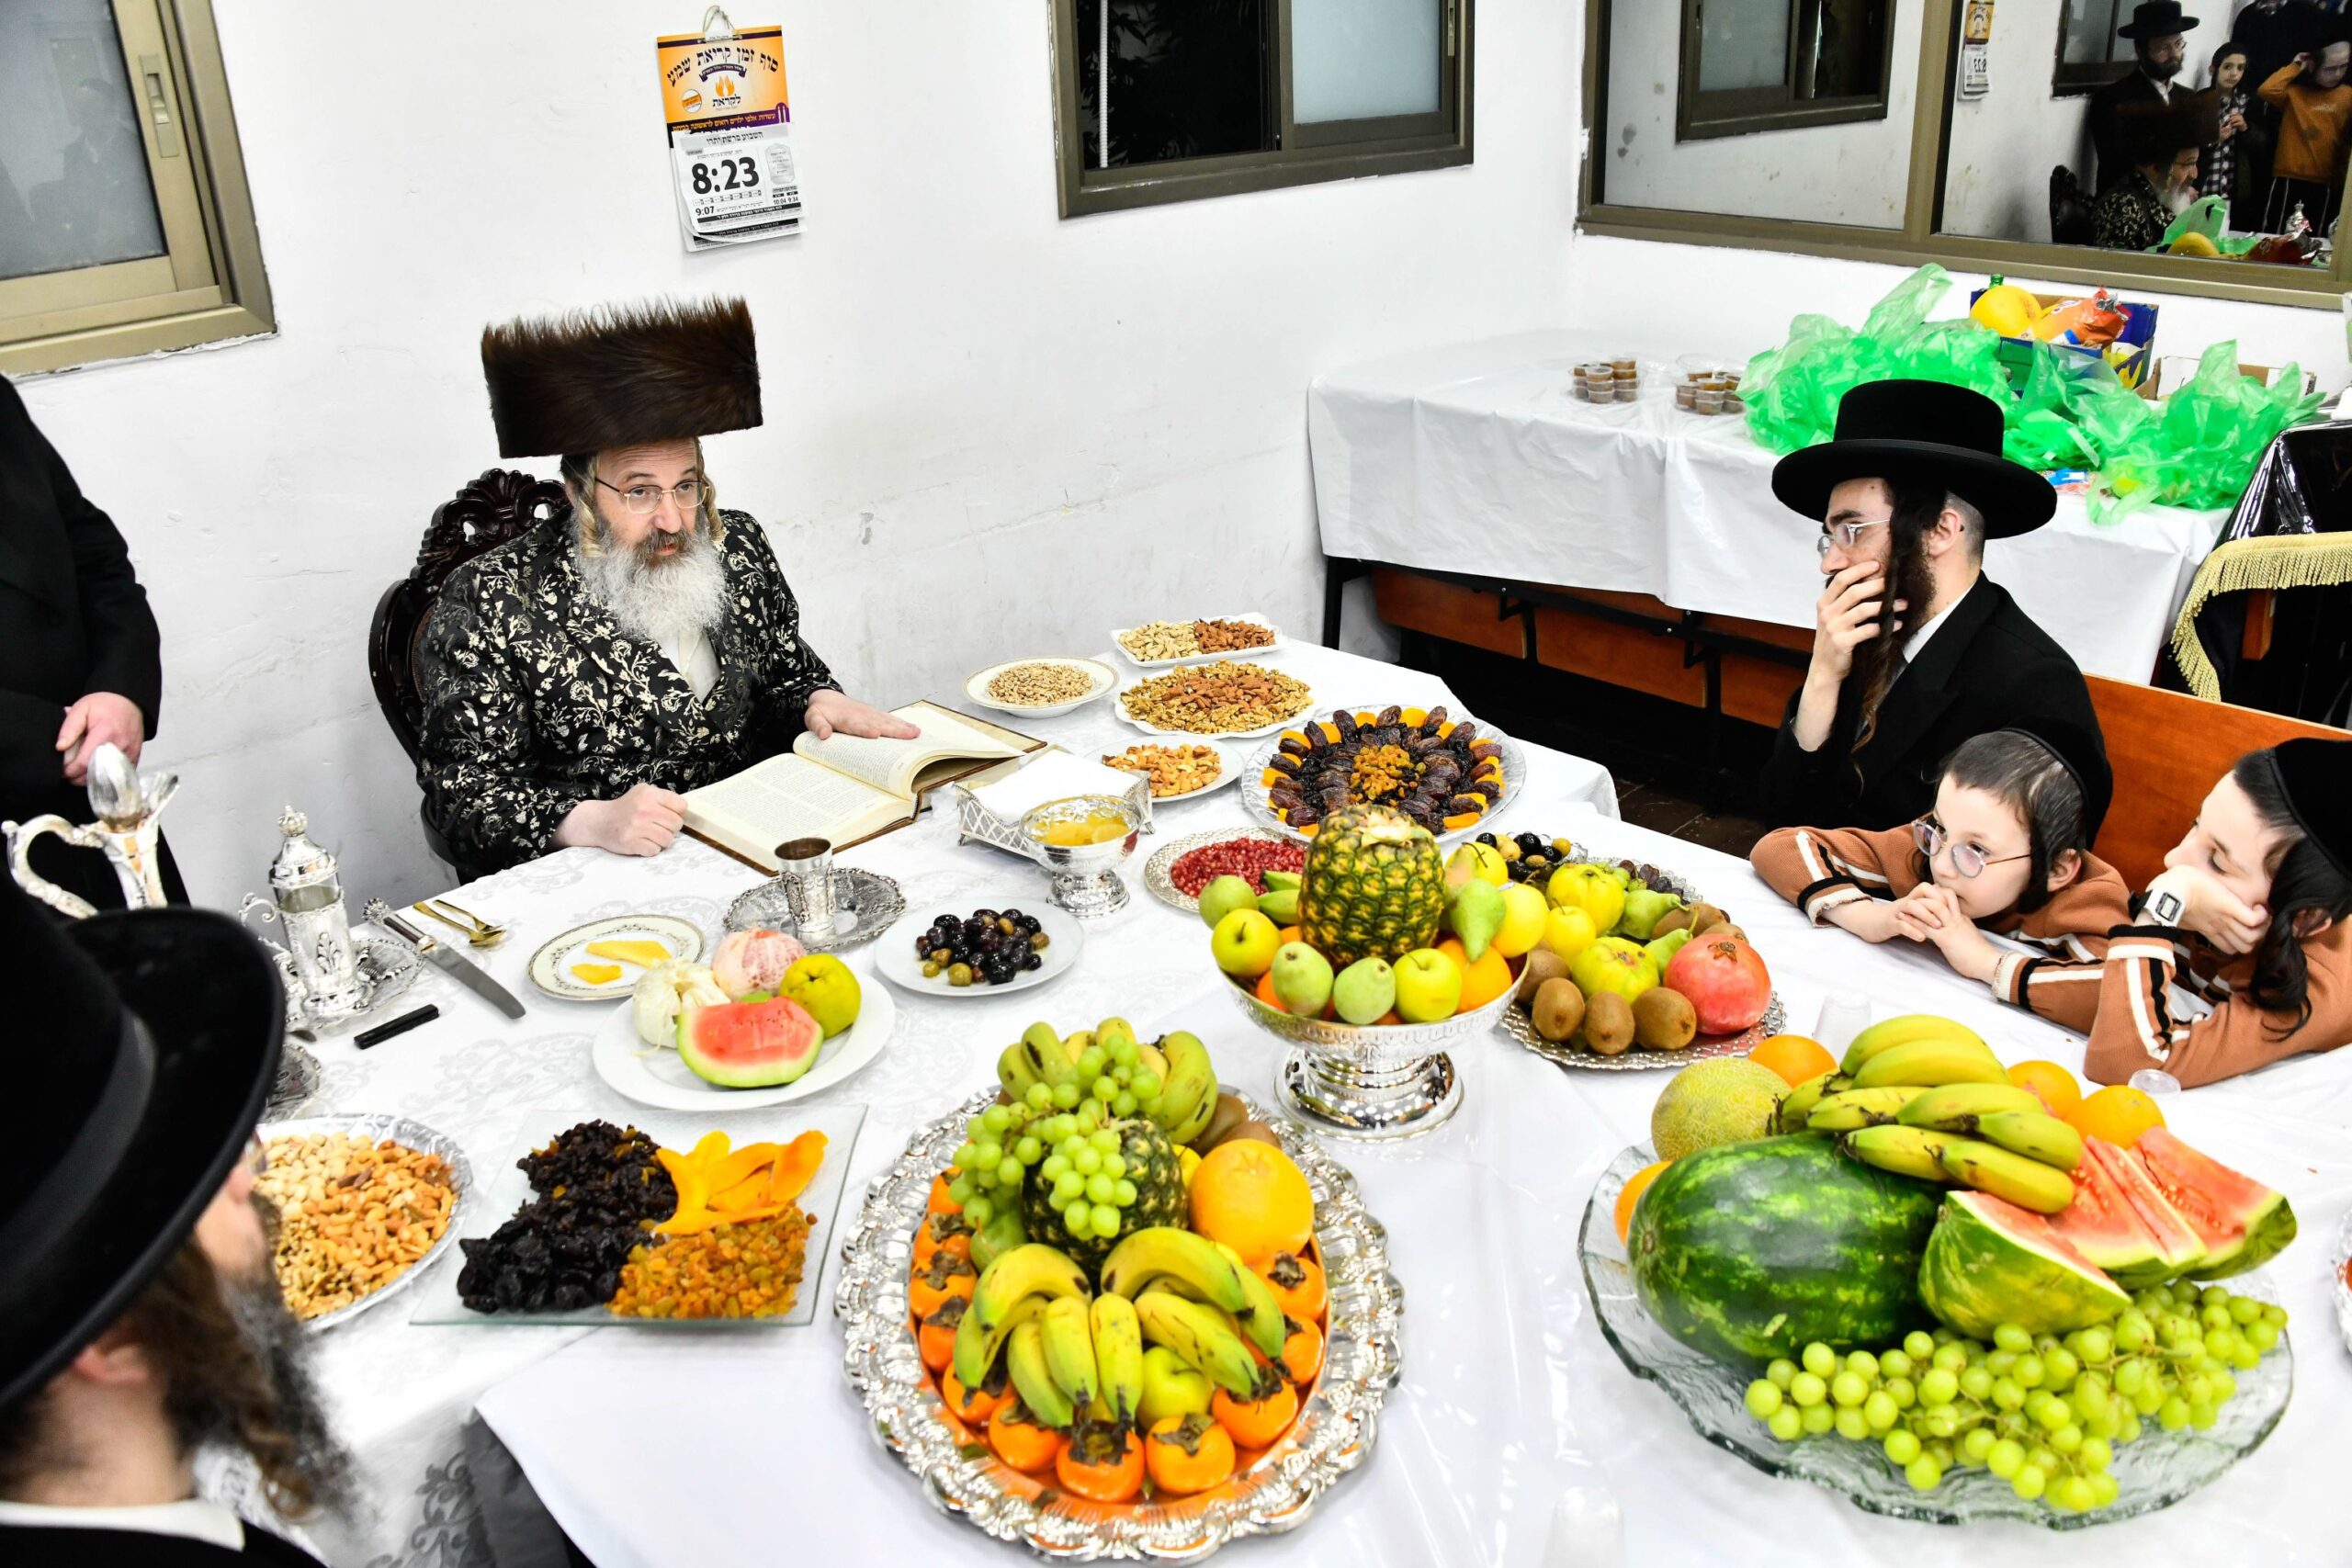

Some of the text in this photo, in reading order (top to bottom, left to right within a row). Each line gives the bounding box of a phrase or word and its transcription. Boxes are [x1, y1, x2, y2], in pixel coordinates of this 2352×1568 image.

[666, 47, 779, 87] סוף זמן קריאת שמע
[712, 94, 741, 107] לקראת
[690, 120, 714, 130] לראשונה
[745, 115, 758, 123] אלפי
[706, 131, 763, 146] השבוע פרשת יתרו
[691, 156, 760, 195] 8:23
[695, 205, 715, 216] 9:07
